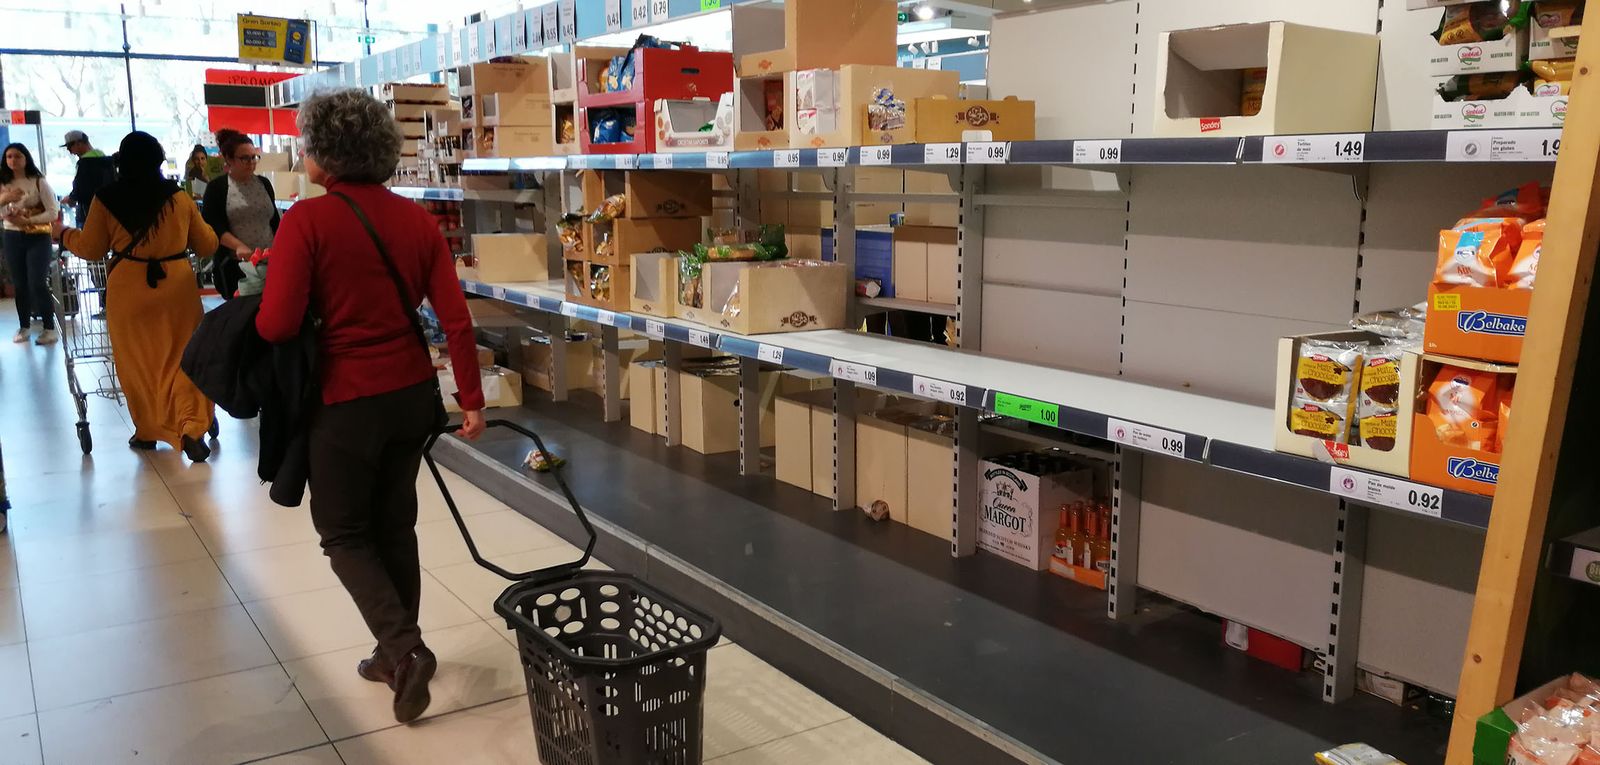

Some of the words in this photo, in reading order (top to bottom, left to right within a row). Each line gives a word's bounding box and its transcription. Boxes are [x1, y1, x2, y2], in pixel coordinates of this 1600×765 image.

[633, 6, 647, 20] 0.42
[653, 1, 667, 15] 0.79
[876, 149, 890, 160] 0.99
[945, 147, 959, 158] 1.29
[987, 147, 1004, 158] 0.99
[1099, 147, 1118, 160] 0.99
[1335, 141, 1362, 156] 1.49
[832, 151, 845, 162] 0.99
[864, 370, 876, 381] 1.09
[949, 388, 965, 402] 0.92
[1040, 408, 1055, 422] 1.00
[1162, 437, 1183, 453] 0.99
[992, 497, 1016, 513] Queen
[1408, 490, 1440, 510] 0.92
[984, 505, 1027, 533] MARGOT
[1589, 562, 1600, 576] BI
